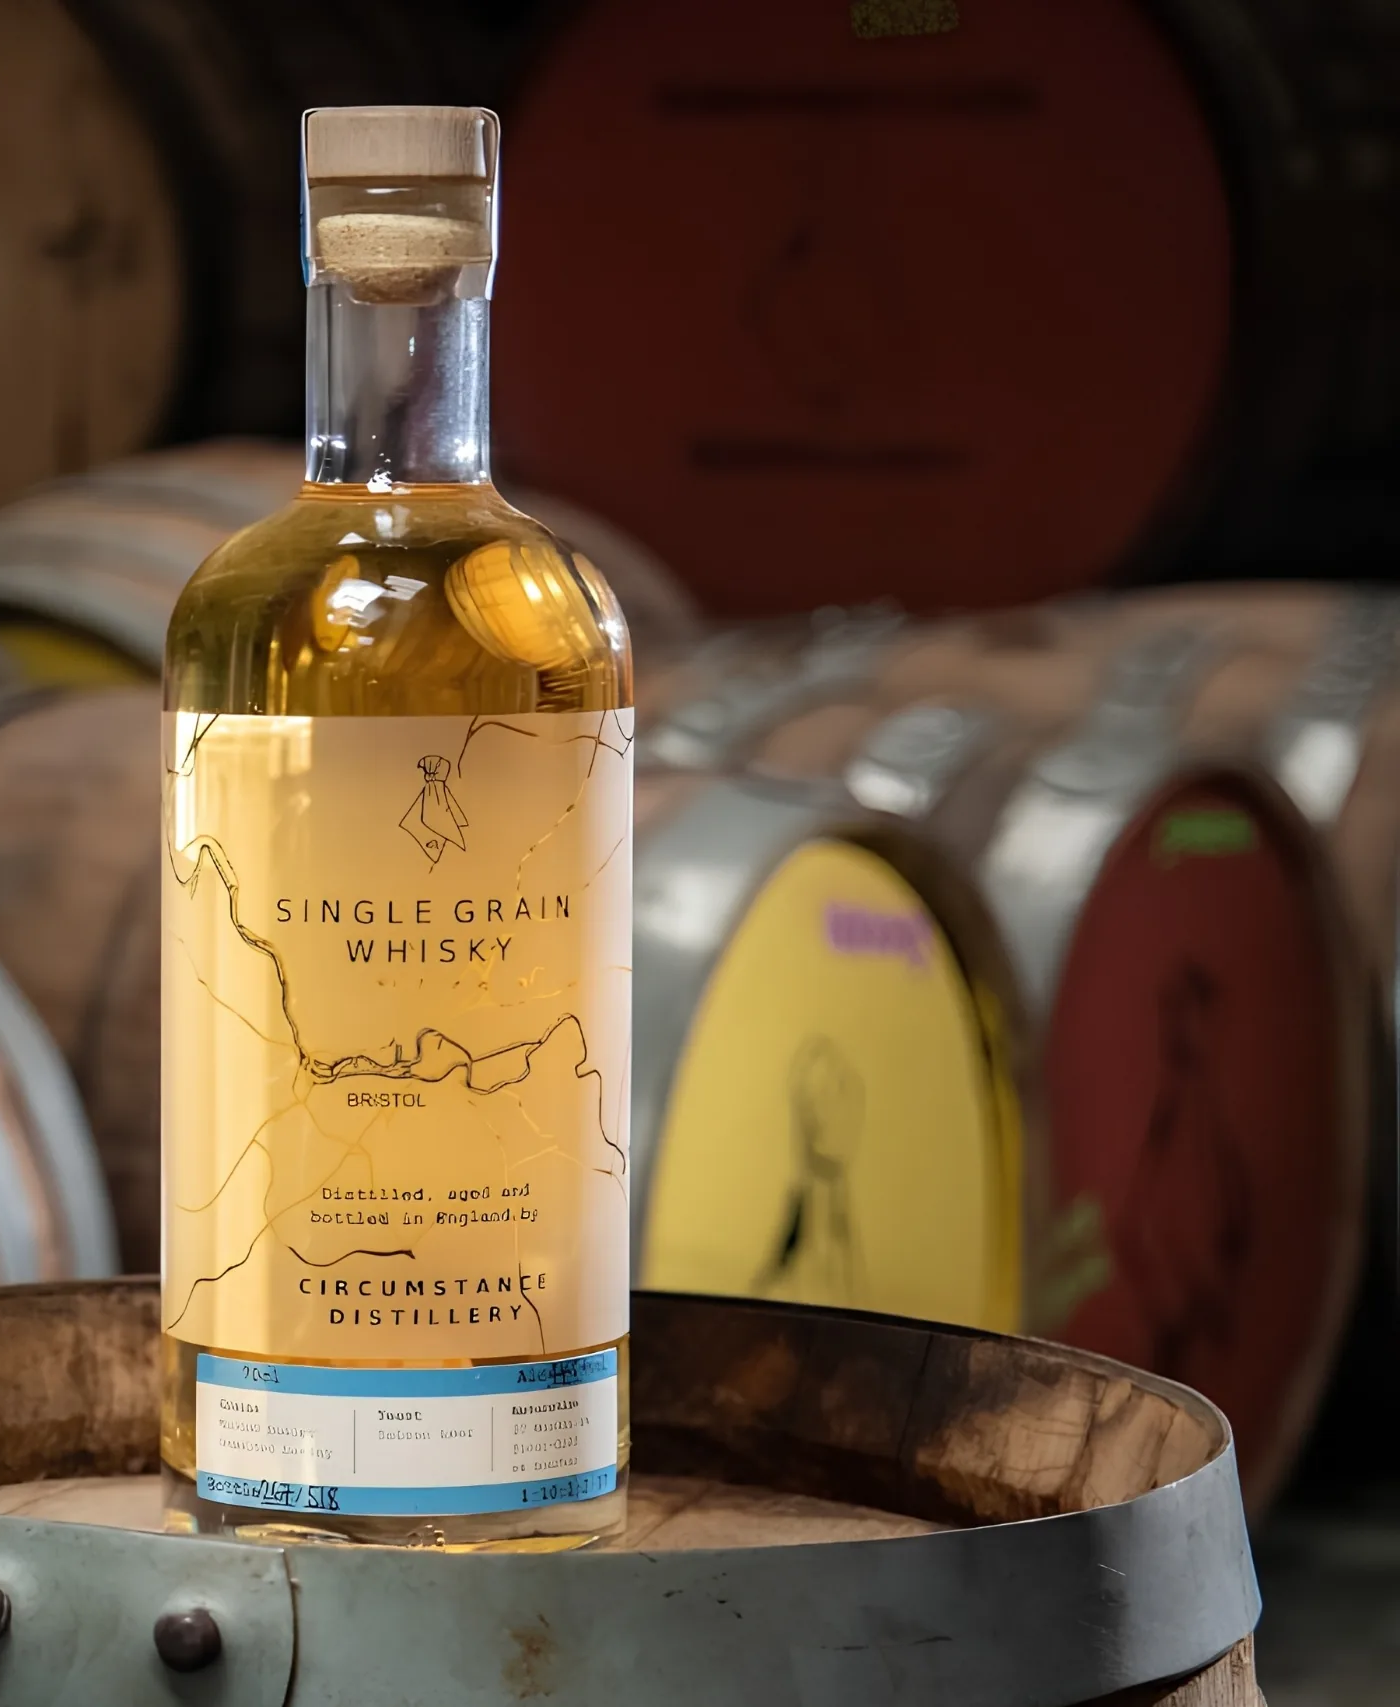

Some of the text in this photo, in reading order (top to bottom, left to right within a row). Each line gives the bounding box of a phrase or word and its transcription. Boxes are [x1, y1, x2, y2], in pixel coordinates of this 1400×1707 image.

[276, 894, 571, 924] SINGLE GRAIN
[346, 936, 513, 963] WHISKY
[346, 1092, 427, 1108] BRISTOL
[402, 1211, 424, 1225] in
[299, 1272, 547, 1297] CIRCUMSTANCE
[329, 1304, 522, 1326] DISTILLERY
